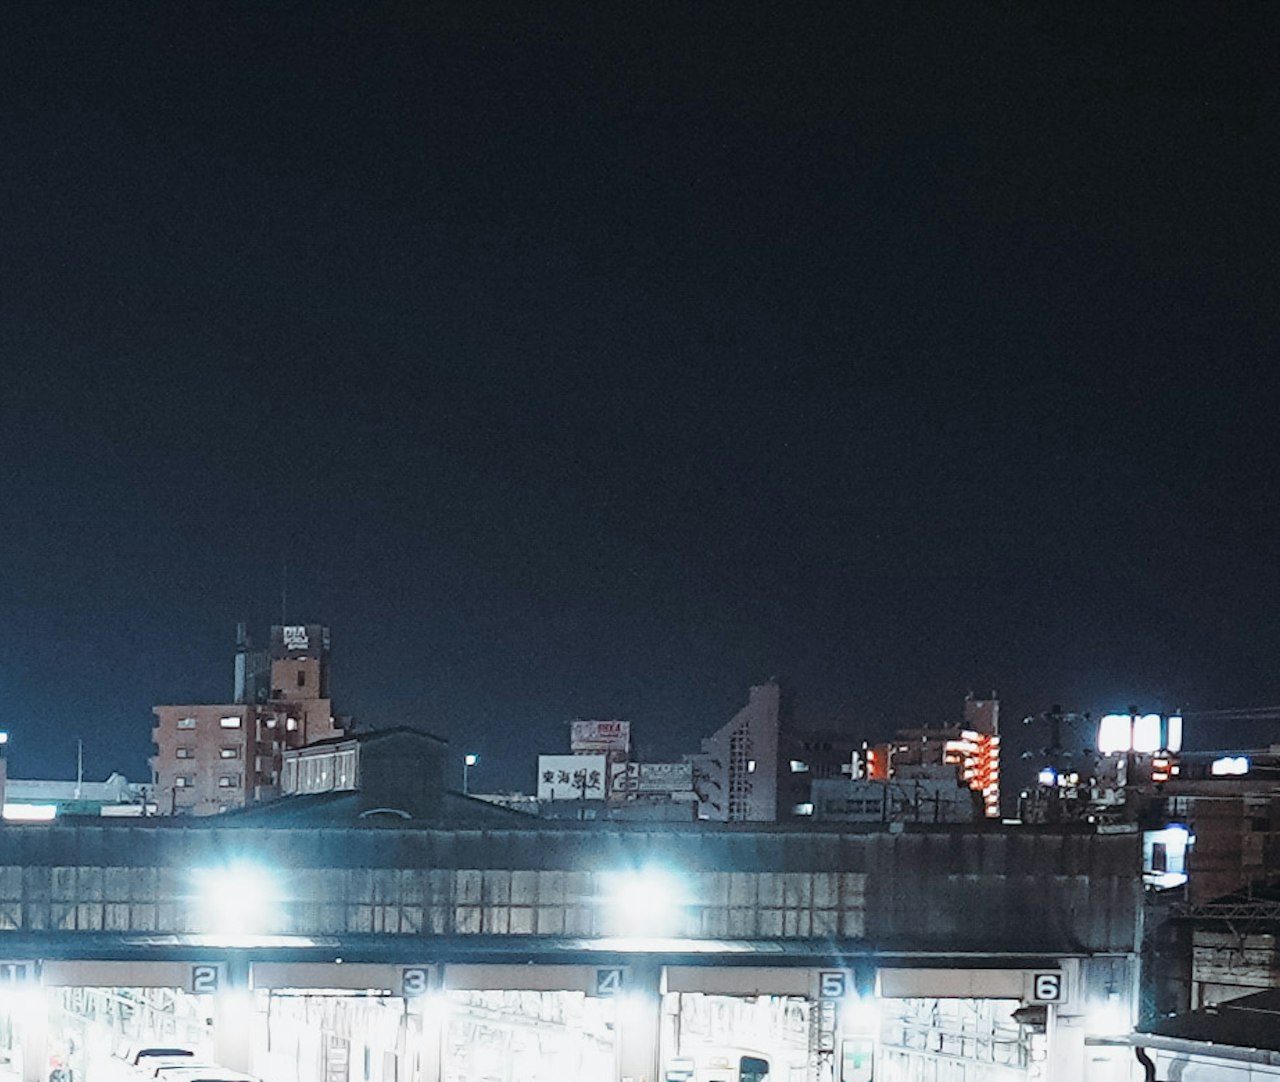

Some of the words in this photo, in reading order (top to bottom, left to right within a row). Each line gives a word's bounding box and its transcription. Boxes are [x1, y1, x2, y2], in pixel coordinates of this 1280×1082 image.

[195, 968, 216, 990] 2
[405, 969, 426, 993] 3
[598, 971, 621, 994] 4
[822, 974, 843, 996] 5
[1037, 975, 1058, 997] 6
